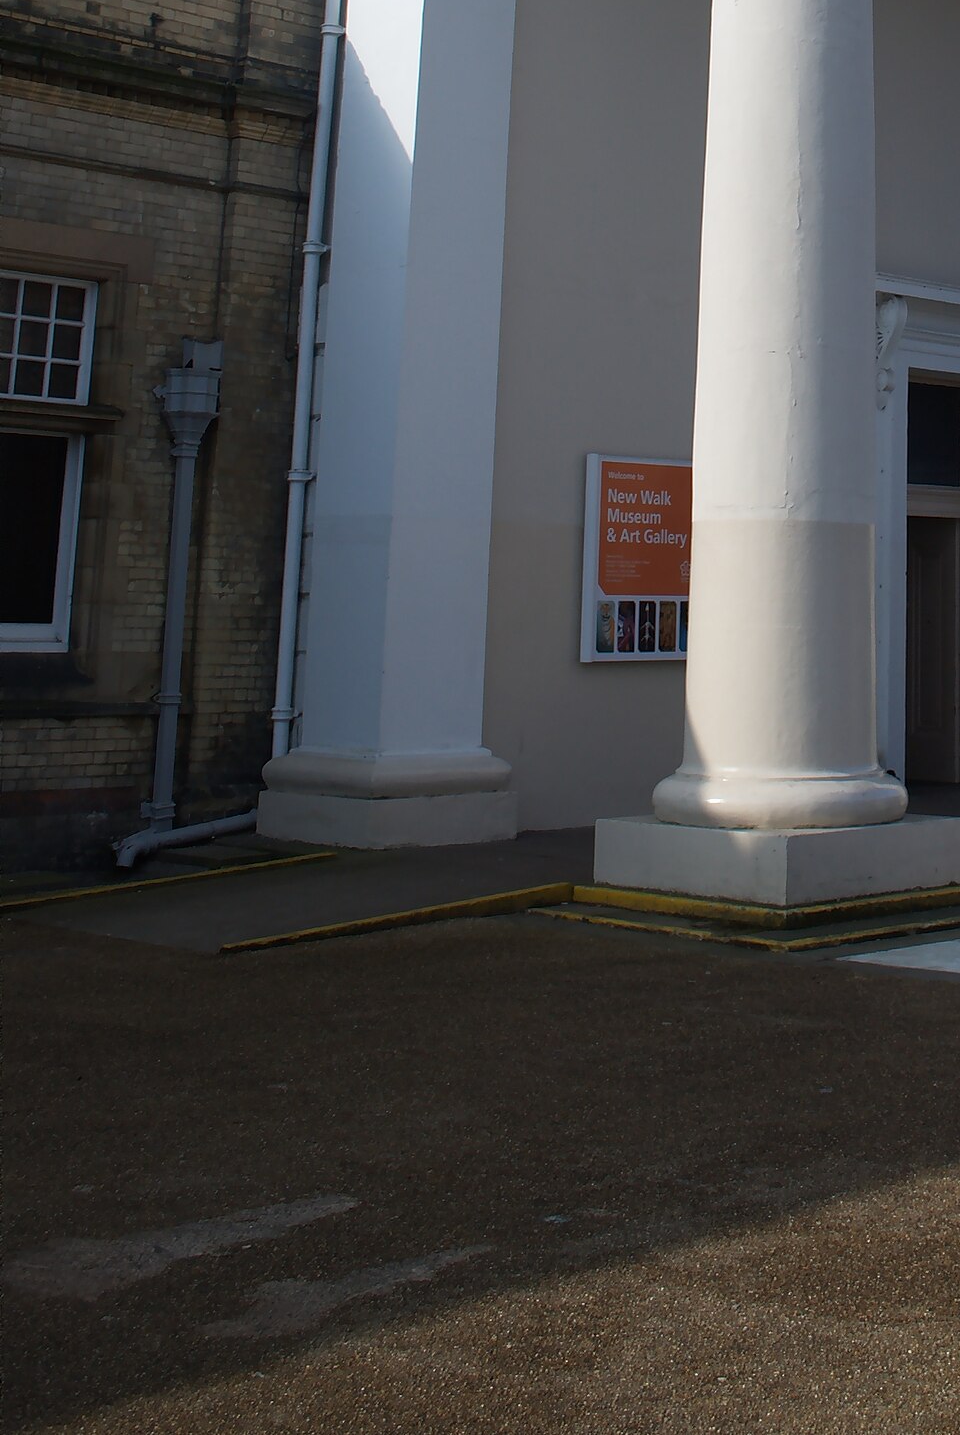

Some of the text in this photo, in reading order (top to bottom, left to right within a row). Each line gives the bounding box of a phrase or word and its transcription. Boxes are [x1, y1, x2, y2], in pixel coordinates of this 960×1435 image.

[608, 471, 636, 480] Welcome
[607, 488, 671, 505] New Walk
[607, 508, 661, 524] Museum
[606, 527, 687, 548] & Art Gallery
